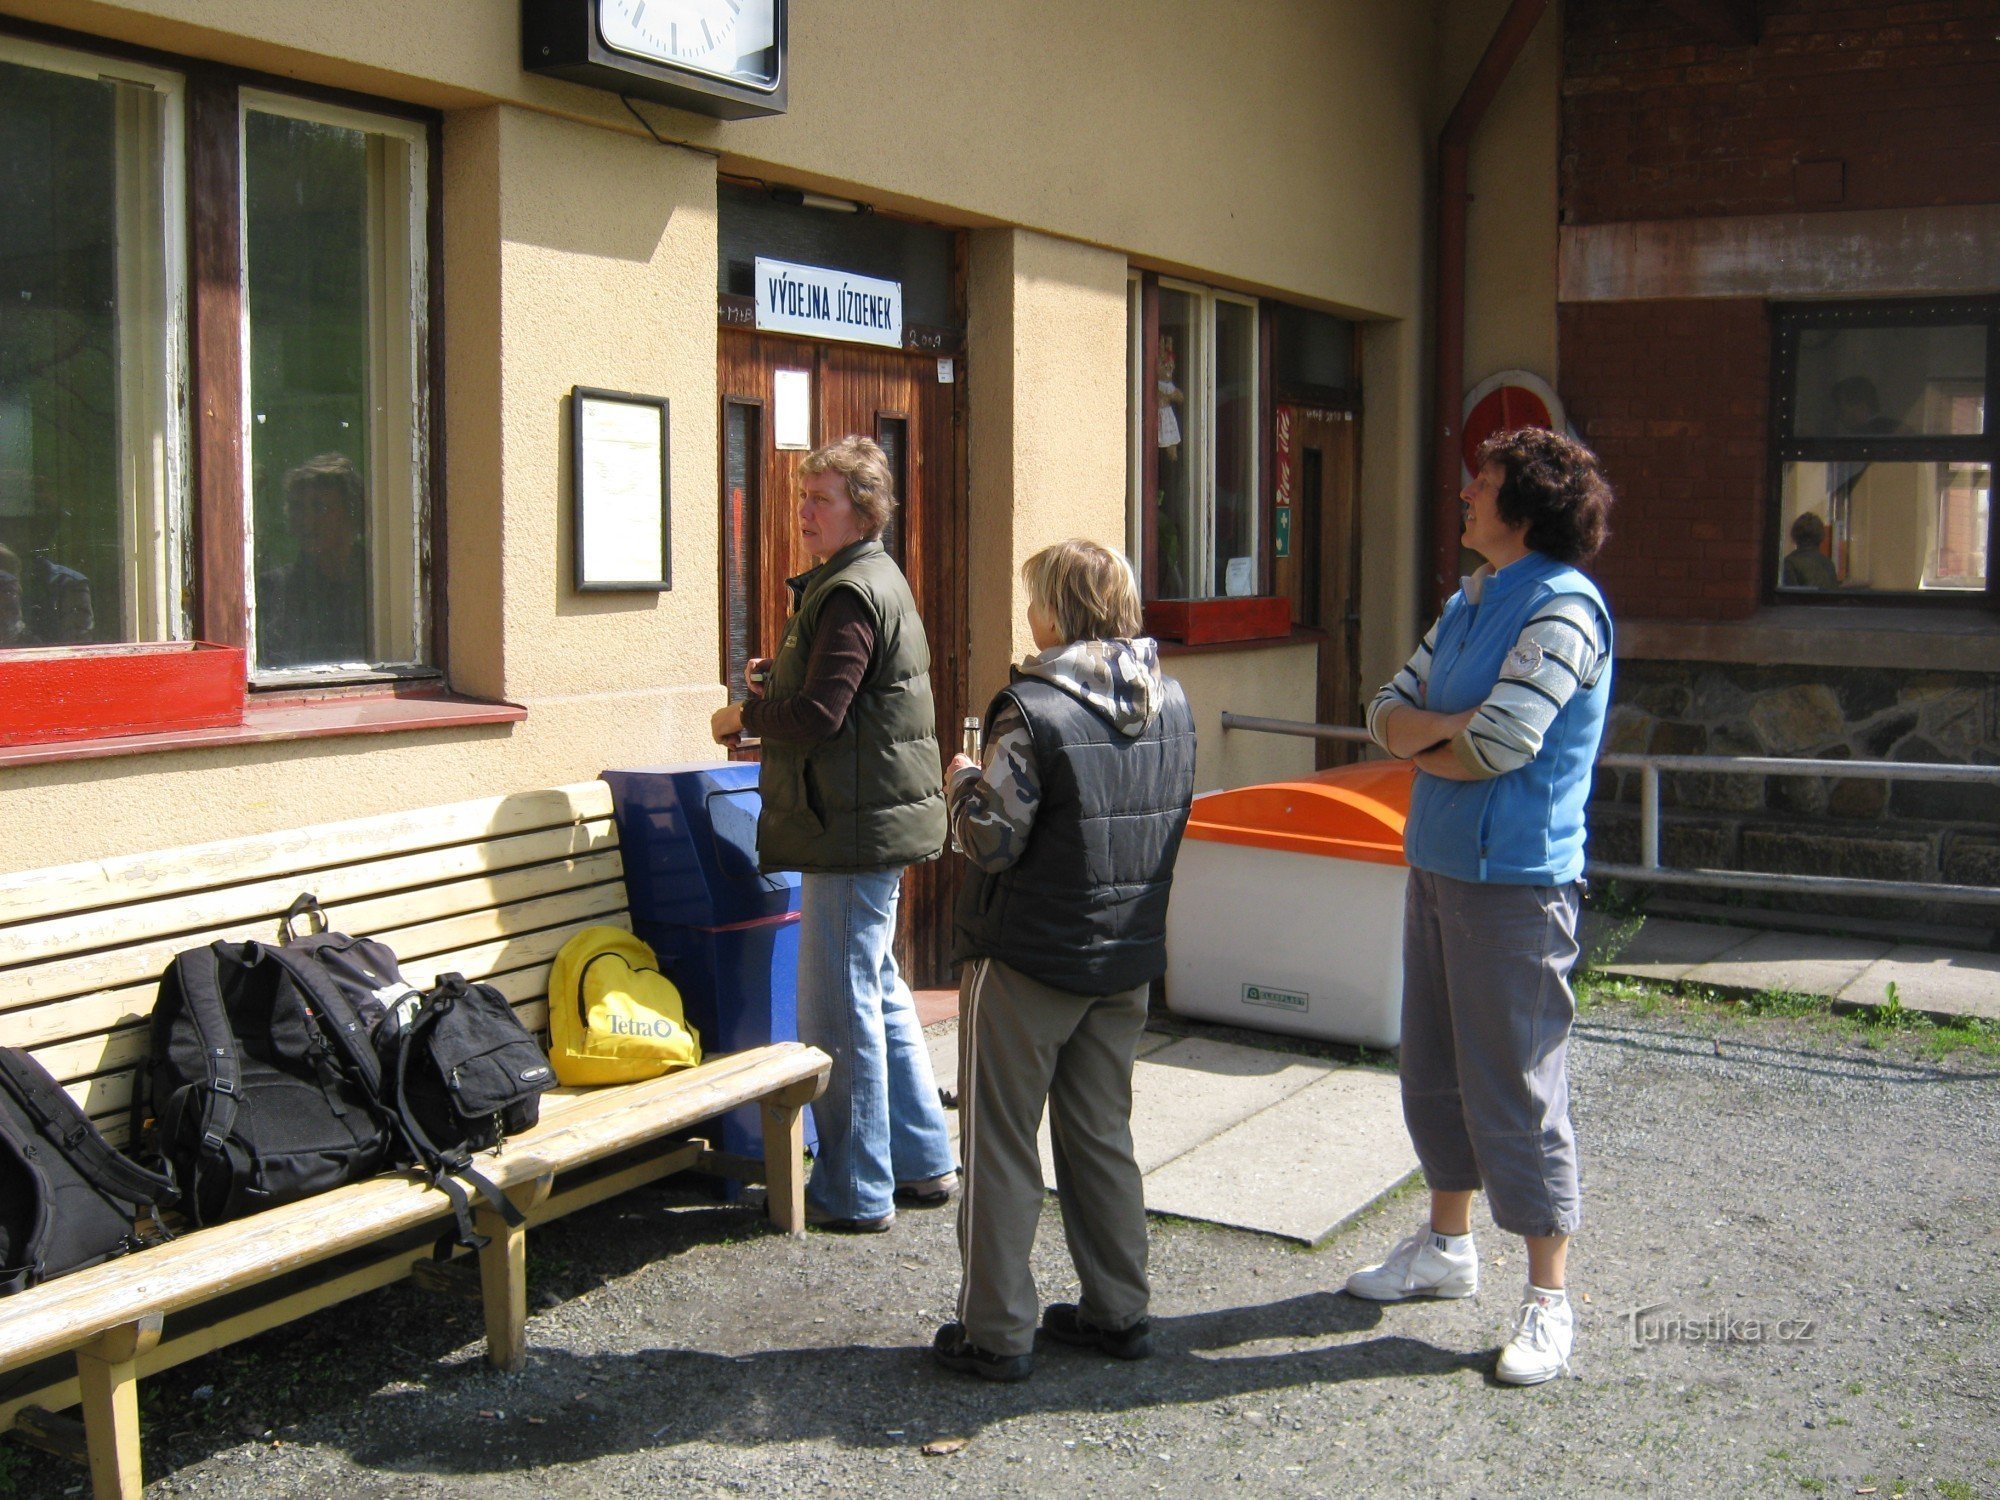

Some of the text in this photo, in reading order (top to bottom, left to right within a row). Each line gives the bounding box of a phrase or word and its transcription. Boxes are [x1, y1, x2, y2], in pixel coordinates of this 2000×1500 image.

[768, 271, 892, 330] VÝDEJNA JÍZDENEK
[605, 1014, 653, 1037] Tetra
